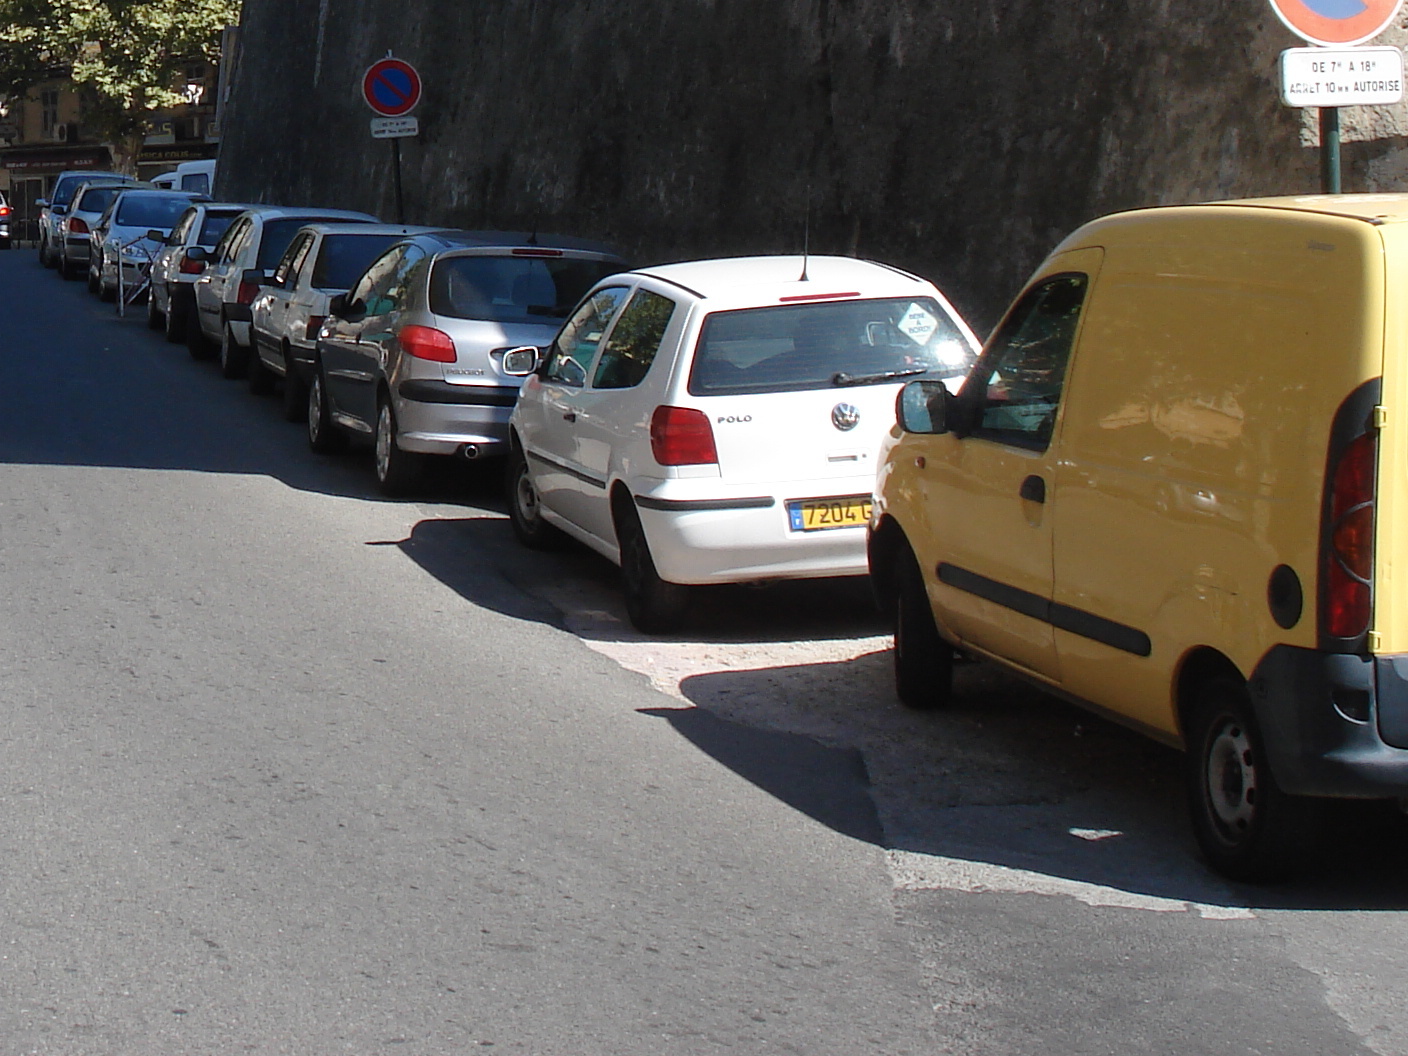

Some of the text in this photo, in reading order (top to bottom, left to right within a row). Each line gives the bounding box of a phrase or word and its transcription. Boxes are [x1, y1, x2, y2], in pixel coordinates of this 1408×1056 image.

[1312, 62, 1325, 73] DE
[1354, 80, 1400, 92] AUTORISE
[717, 415, 752, 424] POLO
[804, 501, 856, 525] 7204
